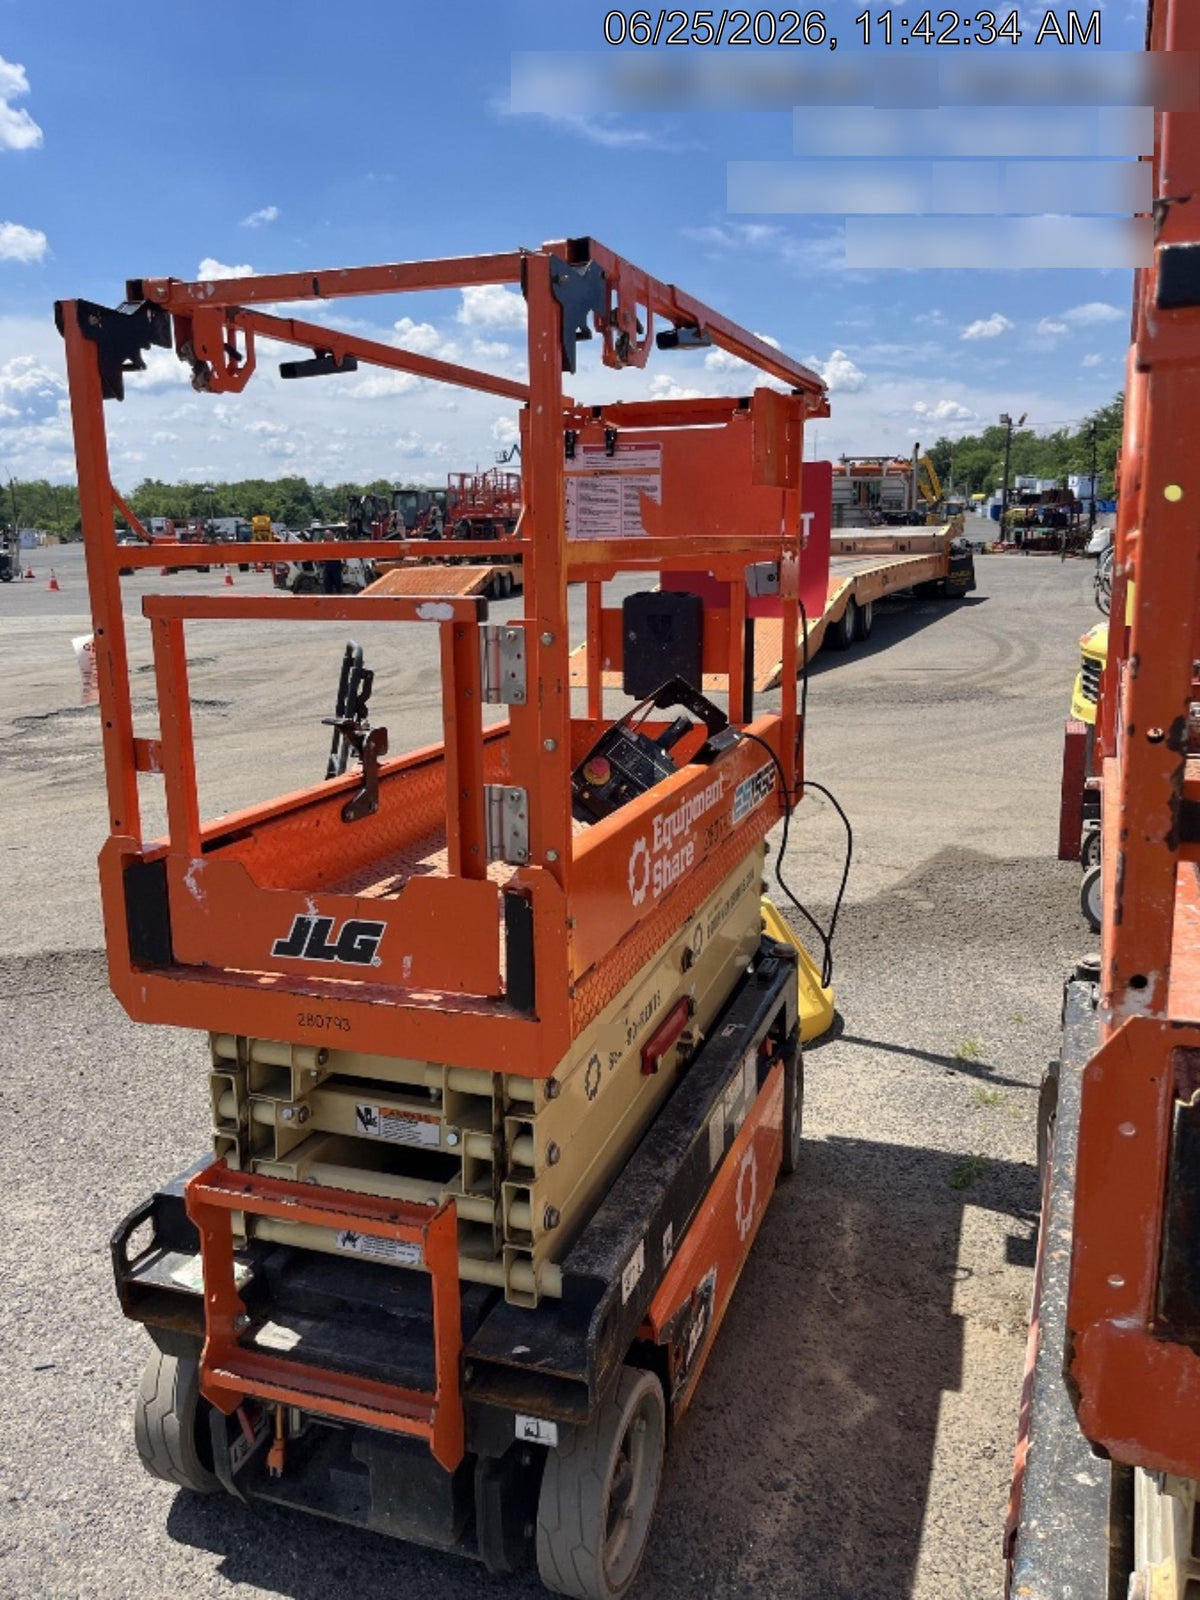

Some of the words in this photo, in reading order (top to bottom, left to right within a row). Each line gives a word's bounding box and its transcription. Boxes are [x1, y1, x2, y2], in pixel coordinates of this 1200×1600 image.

[653, 772, 724, 853] Equipment
[653, 841, 695, 898] Share
[270, 914, 387, 966] JLG
[297, 1012, 352, 1032] 280793
